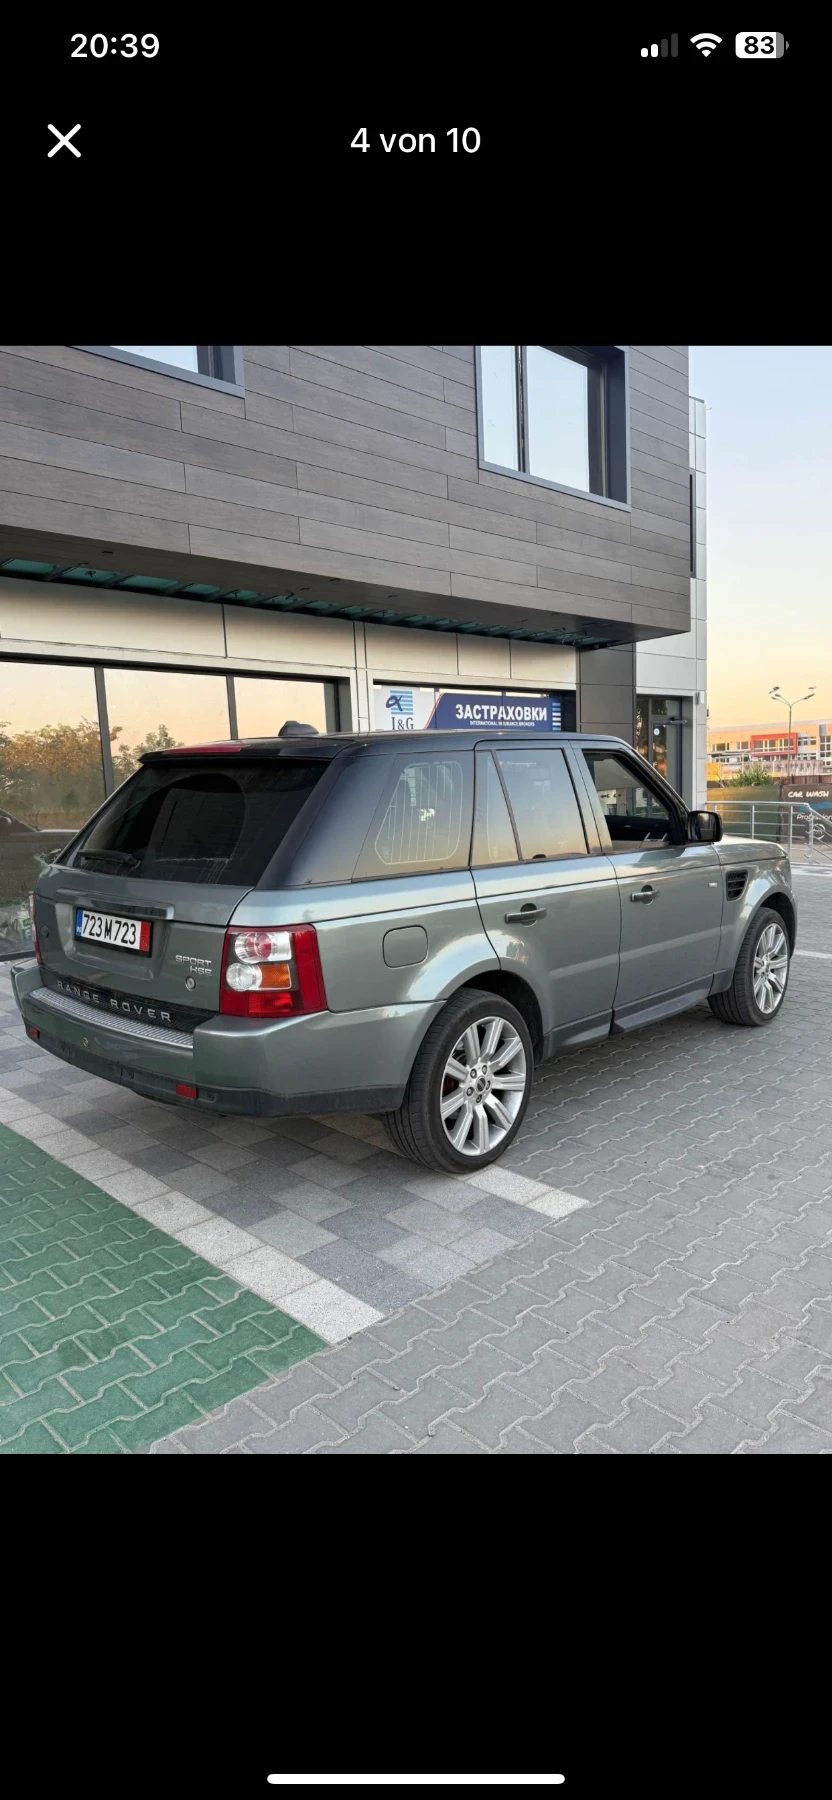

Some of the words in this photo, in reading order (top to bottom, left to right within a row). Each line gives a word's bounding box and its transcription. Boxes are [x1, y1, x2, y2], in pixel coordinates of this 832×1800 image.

[455, 703, 548, 721] ЗАСТРАХОВКИ
[175, 954, 212, 967] SPORT
[189, 965, 212, 976] HSE
[57, 980, 100, 1003] RANGE
[110, 998, 172, 1023] ROVER
